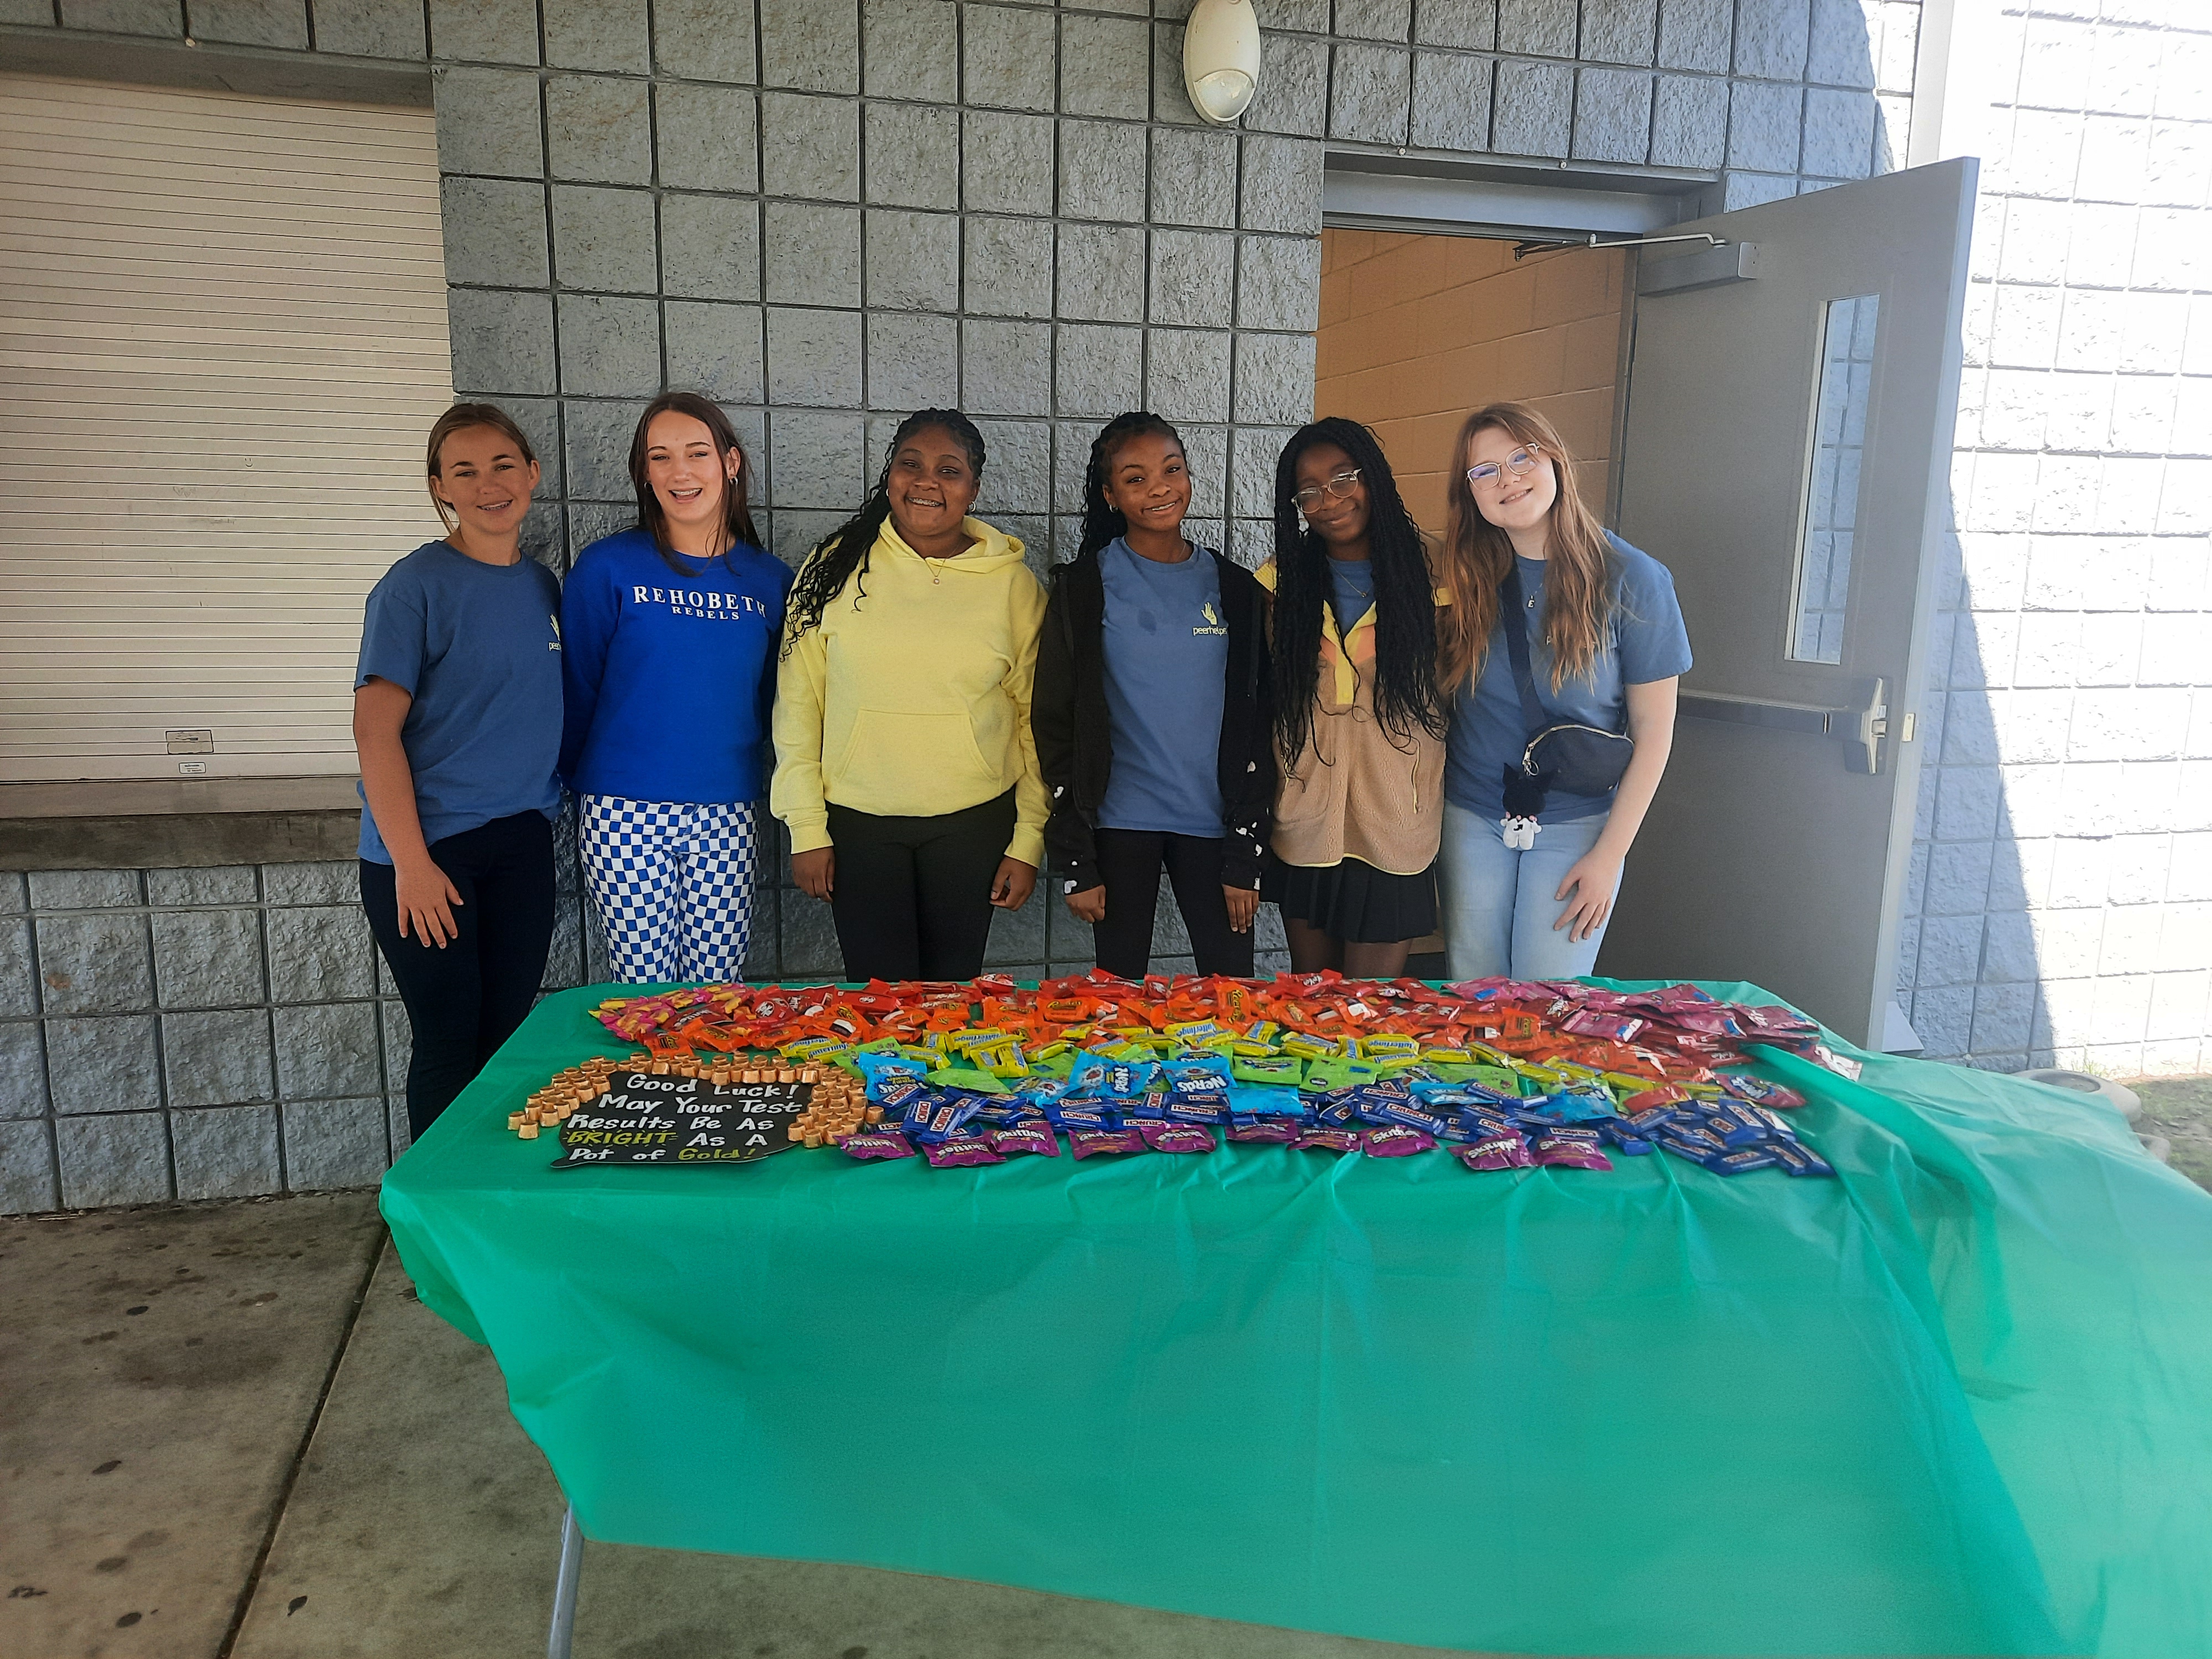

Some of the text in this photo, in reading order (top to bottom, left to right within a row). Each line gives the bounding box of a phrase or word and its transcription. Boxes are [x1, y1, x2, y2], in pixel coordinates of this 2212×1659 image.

[632, 586, 766, 618] REHOBETH
[671, 606, 740, 620] REBELS
[627, 1073, 799, 1099] Good Luck!
[886, 1085, 916, 1103] CRUNCH
[1366, 1089, 1406, 1098] CRUNCH
[598, 1093, 802, 1114] May Your Test
[916, 1102, 930, 1121] CRUNCH
[1173, 1106, 1215, 1114] CRUNCH
[932, 1108, 952, 1130] CRUNCH
[1063, 1112, 1099, 1121] CRUNCH
[1389, 1105, 1431, 1120] CRUNCH
[567, 1114, 775, 1130] Results Be As
[1481, 1120, 1510, 1131] CRUN
[567, 1131, 768, 1147] BRIGHT As A
[569, 1148, 756, 1161] Pot of Gold!
